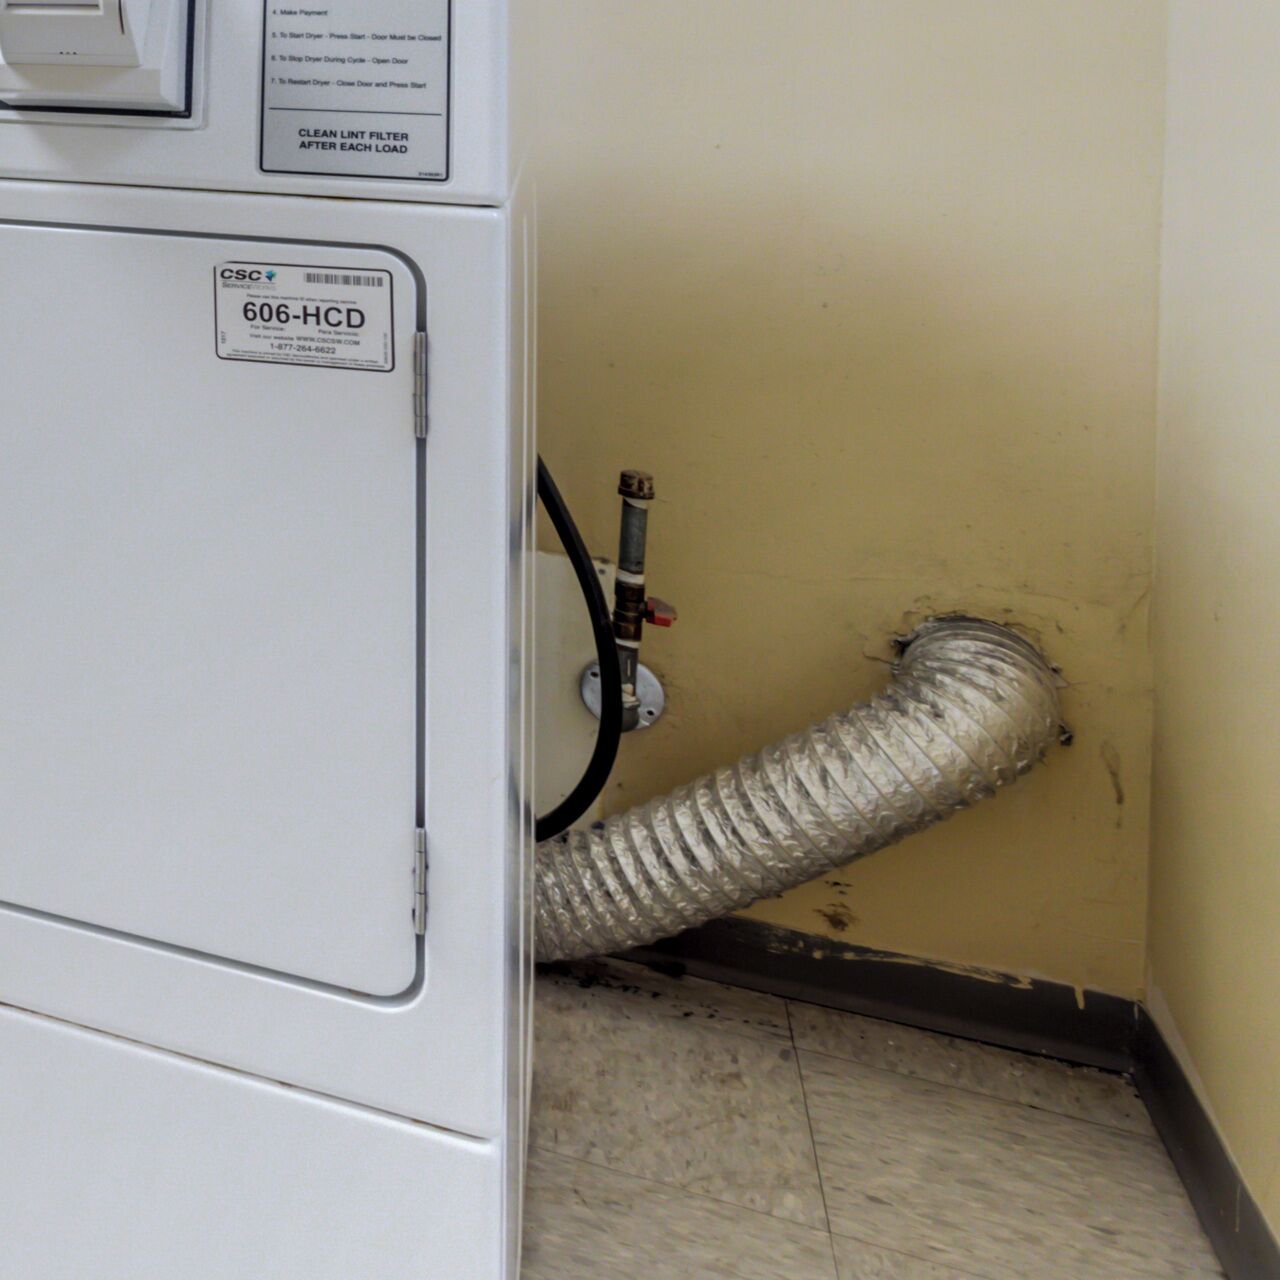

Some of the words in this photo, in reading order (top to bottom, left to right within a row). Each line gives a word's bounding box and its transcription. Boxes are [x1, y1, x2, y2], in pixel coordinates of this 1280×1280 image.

[299, 9, 328, 17] Payment
[305, 32, 323, 40] Dryer
[288, 55, 303, 63] Stop
[304, 55, 322, 63] Dryer
[324, 56, 346, 64] During
[347, 56, 365, 64] Cycle
[371, 56, 390, 64] Open
[287, 78, 311, 86] Restart
[312, 79, 330, 87] Dryer
[298, 128, 338, 139] CLEAN
[341, 130, 366, 140] LINT
[369, 131, 409, 142] FILTER
[299, 141, 337, 151] AFTER
[340, 142, 372, 152] EACH
[375, 143, 408, 153] LOAD
[220, 268, 262, 282] CSC
[243, 301, 366, 329] 606-HCD
[295, 336, 361, 346] WWW.CSCSW.COM
[270, 342, 336, 355] 1-877-264-6622
